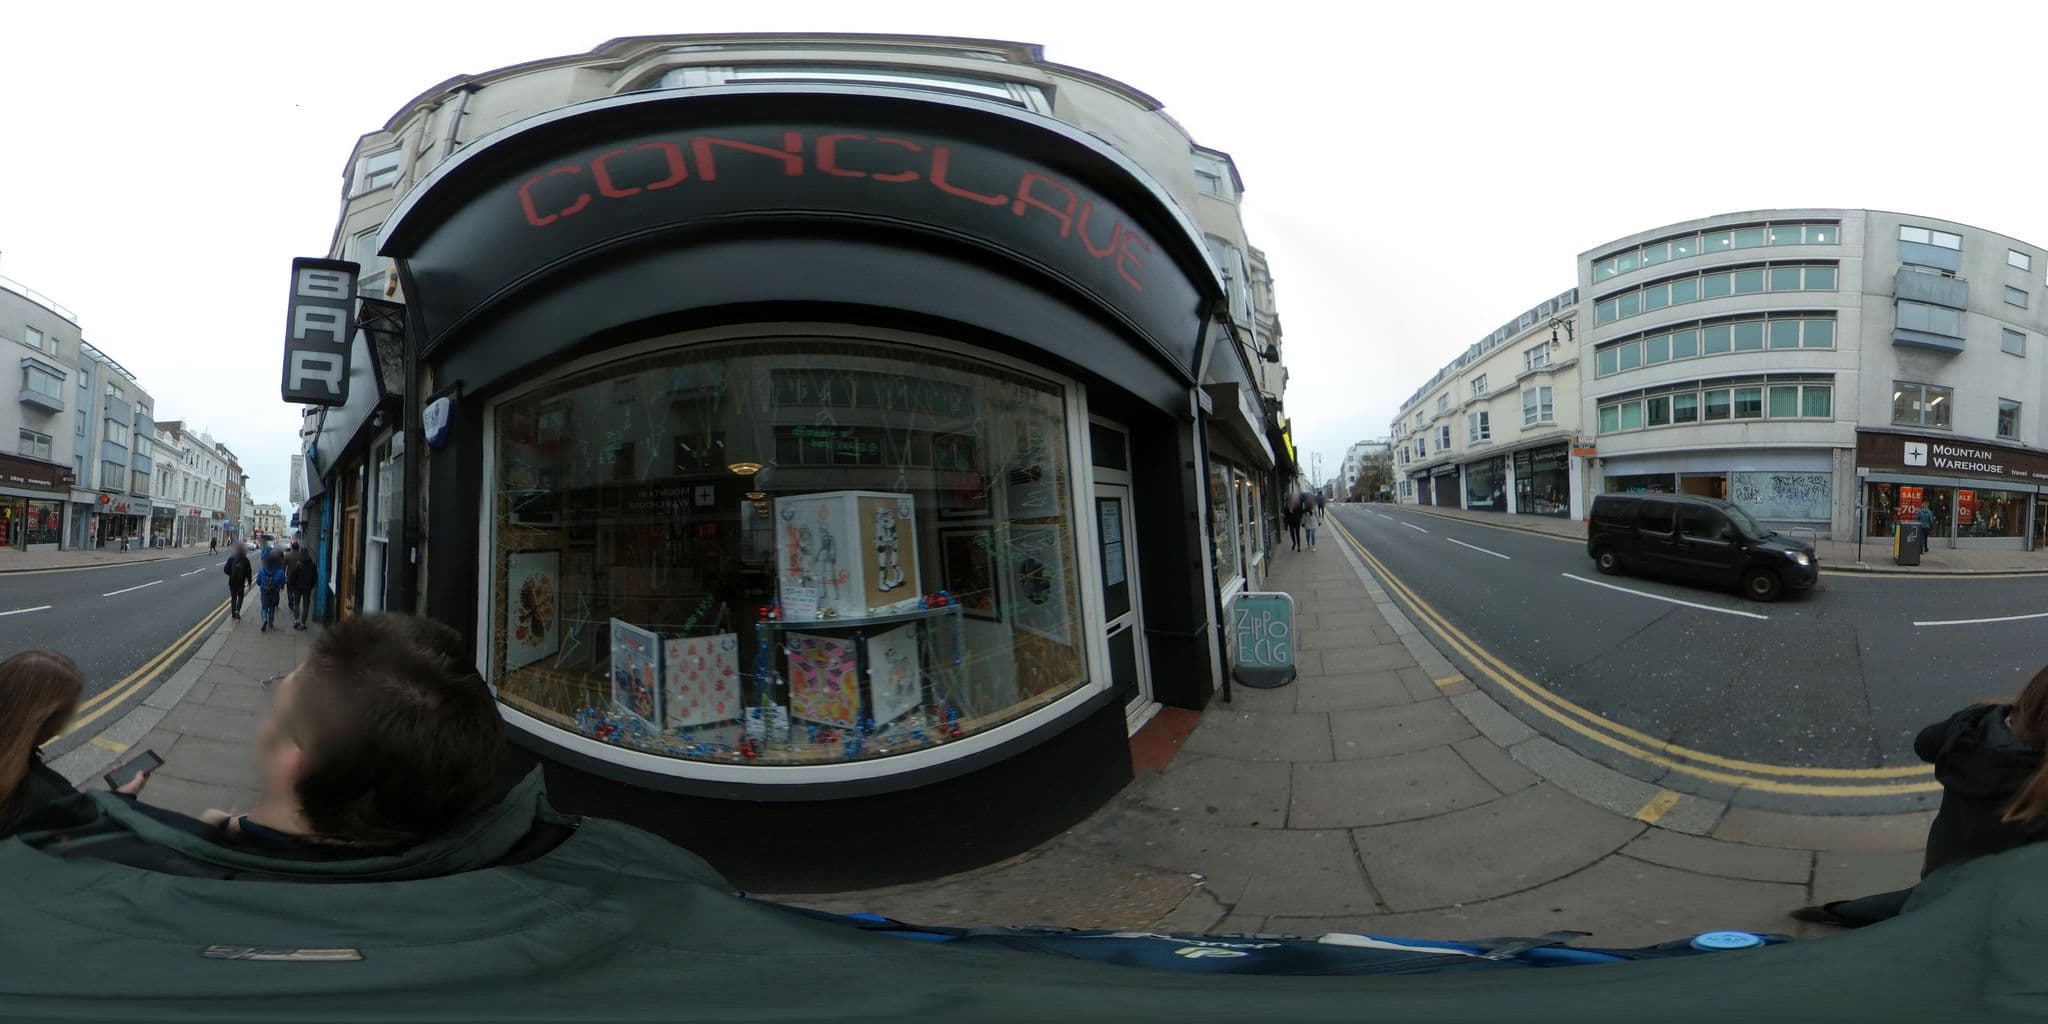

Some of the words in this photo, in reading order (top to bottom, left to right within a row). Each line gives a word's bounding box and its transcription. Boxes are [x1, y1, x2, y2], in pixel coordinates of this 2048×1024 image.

[516, 131, 1153, 292] CONCLAVE
[288, 268, 351, 395] BAR
[1933, 444, 1992, 460] MOUNTAIN
[1933, 457, 2003, 474] WAREHOUSE
[1235, 608, 1288, 640] ZIPPO
